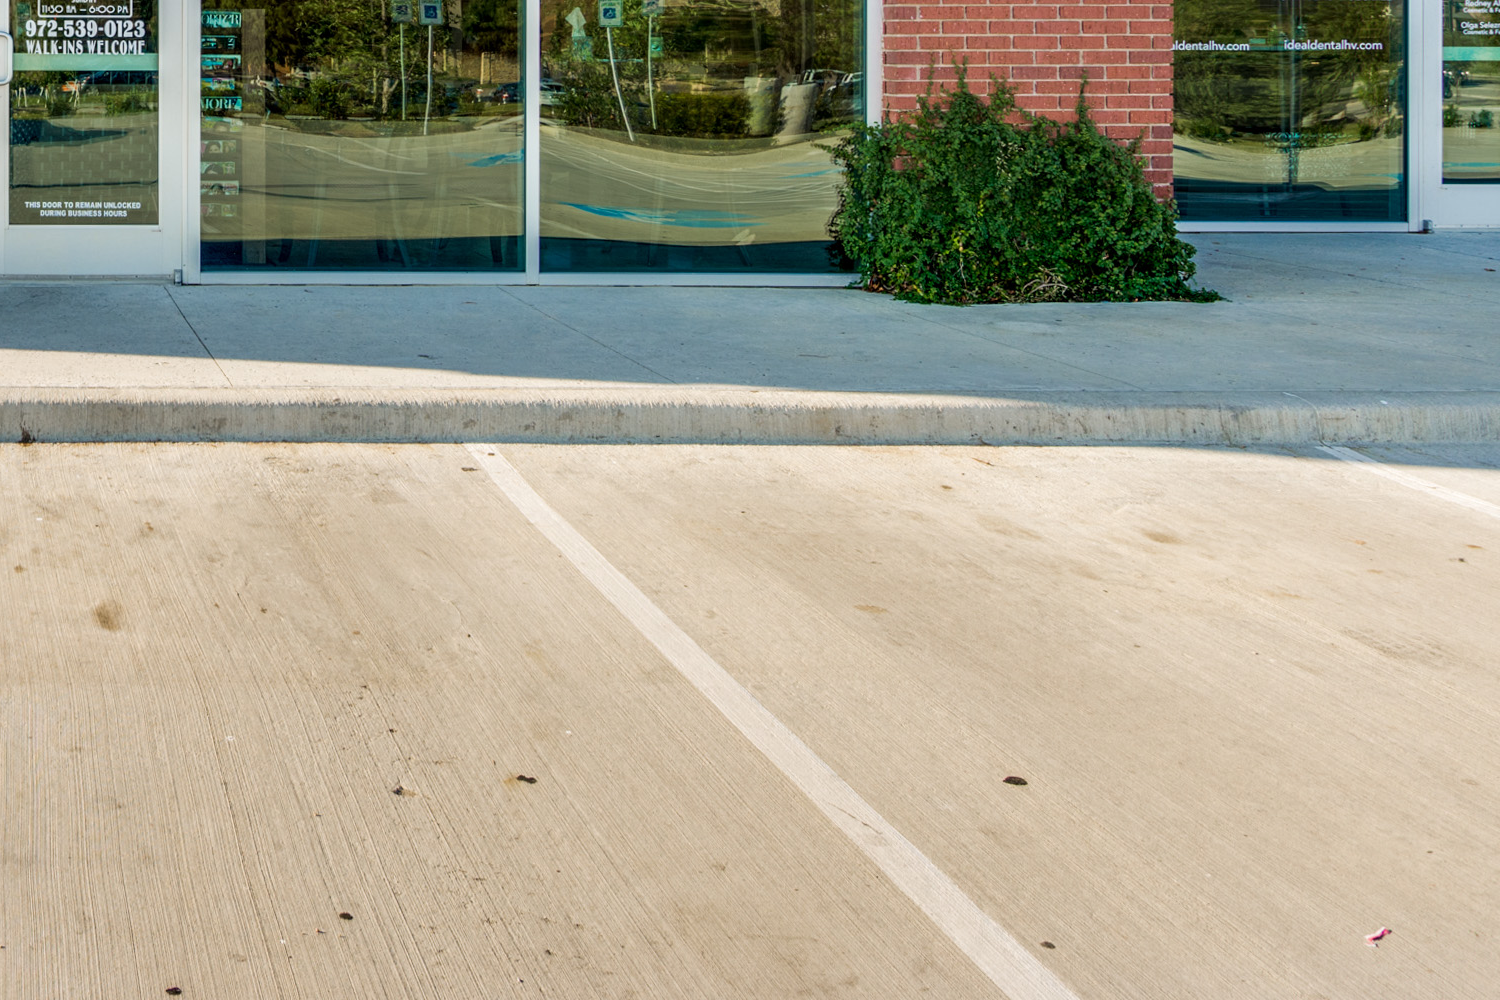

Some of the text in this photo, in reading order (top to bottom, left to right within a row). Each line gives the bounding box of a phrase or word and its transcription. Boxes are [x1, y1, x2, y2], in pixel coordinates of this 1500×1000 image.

[66, 5, 77, 13] AM
[117, 5, 129, 13] PM
[25, 19, 146, 38] 972-539-0123
[1460, 21, 1479, 30] Olga
[26, 40, 146, 55] WALK-INS WELCOME
[1284, 39, 1383, 51] idealdentalhv.com
[24, 201, 142, 209] THIS DOOR TO REMAIN UNLOCKED
[40, 209, 128, 218] DURING BUSINESS HOURS
